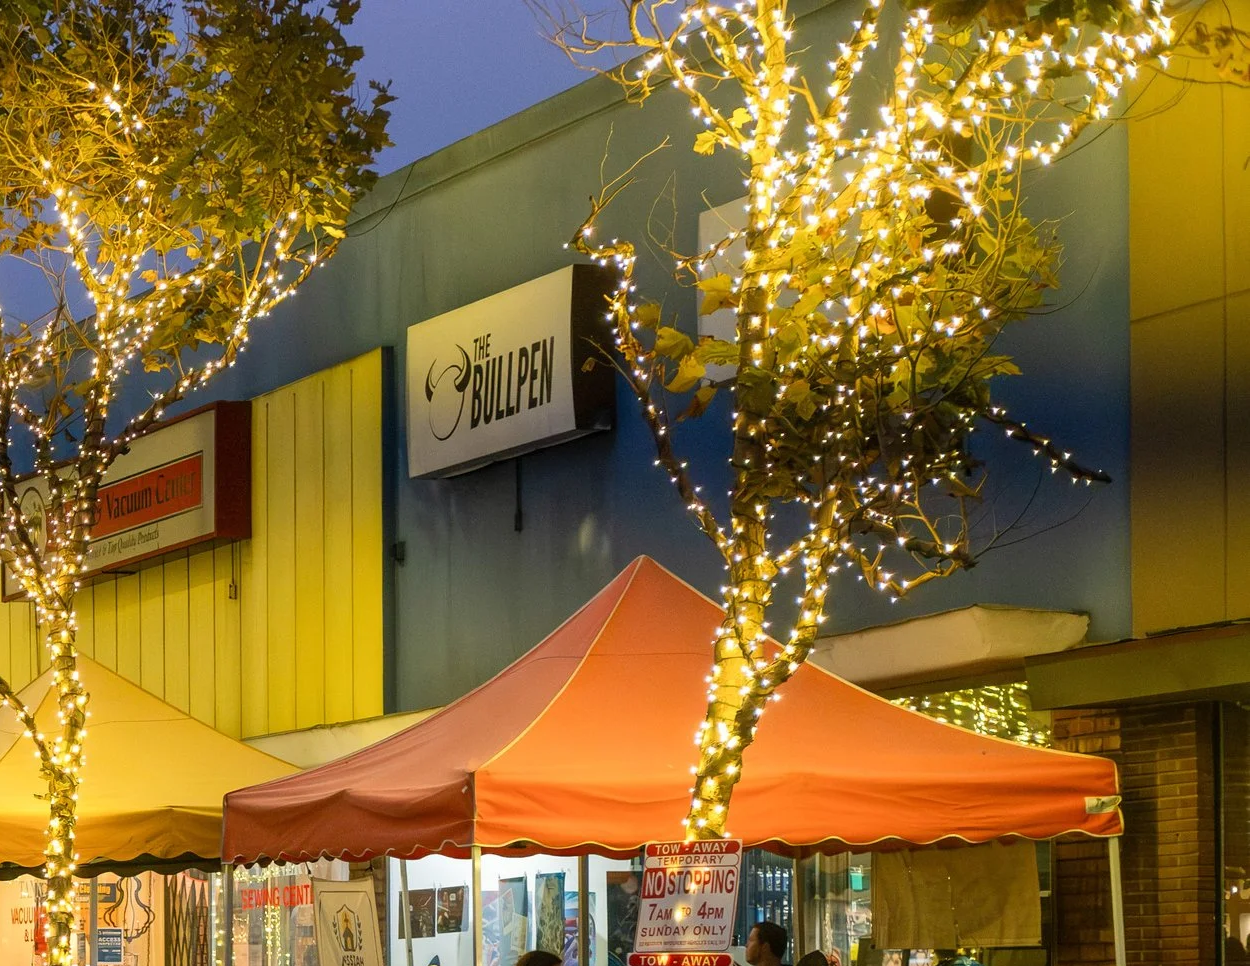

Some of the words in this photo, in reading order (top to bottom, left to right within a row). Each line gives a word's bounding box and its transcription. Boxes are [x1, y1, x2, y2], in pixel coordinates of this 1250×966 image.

[473, 333, 491, 362] THE
[470, 336, 554, 430] BULLPEN
[105, 487, 152, 521] Vacuum
[155, 473, 196, 505] Center
[655, 844, 680, 855] TOW
[693, 842, 728, 853] AWAY
[658, 856, 724, 866] TEMPORARY
[645, 871, 664, 896] NO
[667, 869, 735, 895] STOPPING
[242, 887, 280, 911] SEWING
[649, 903, 672, 920] 7AM
[681, 907, 691, 916] TO
[697, 901, 724, 919] 4PM
[640, 926, 688, 937] SUNDAY
[693, 925, 726, 936] ONLY
[639, 955, 668, 966] TOW
[681, 956, 719, 966] AWAY
